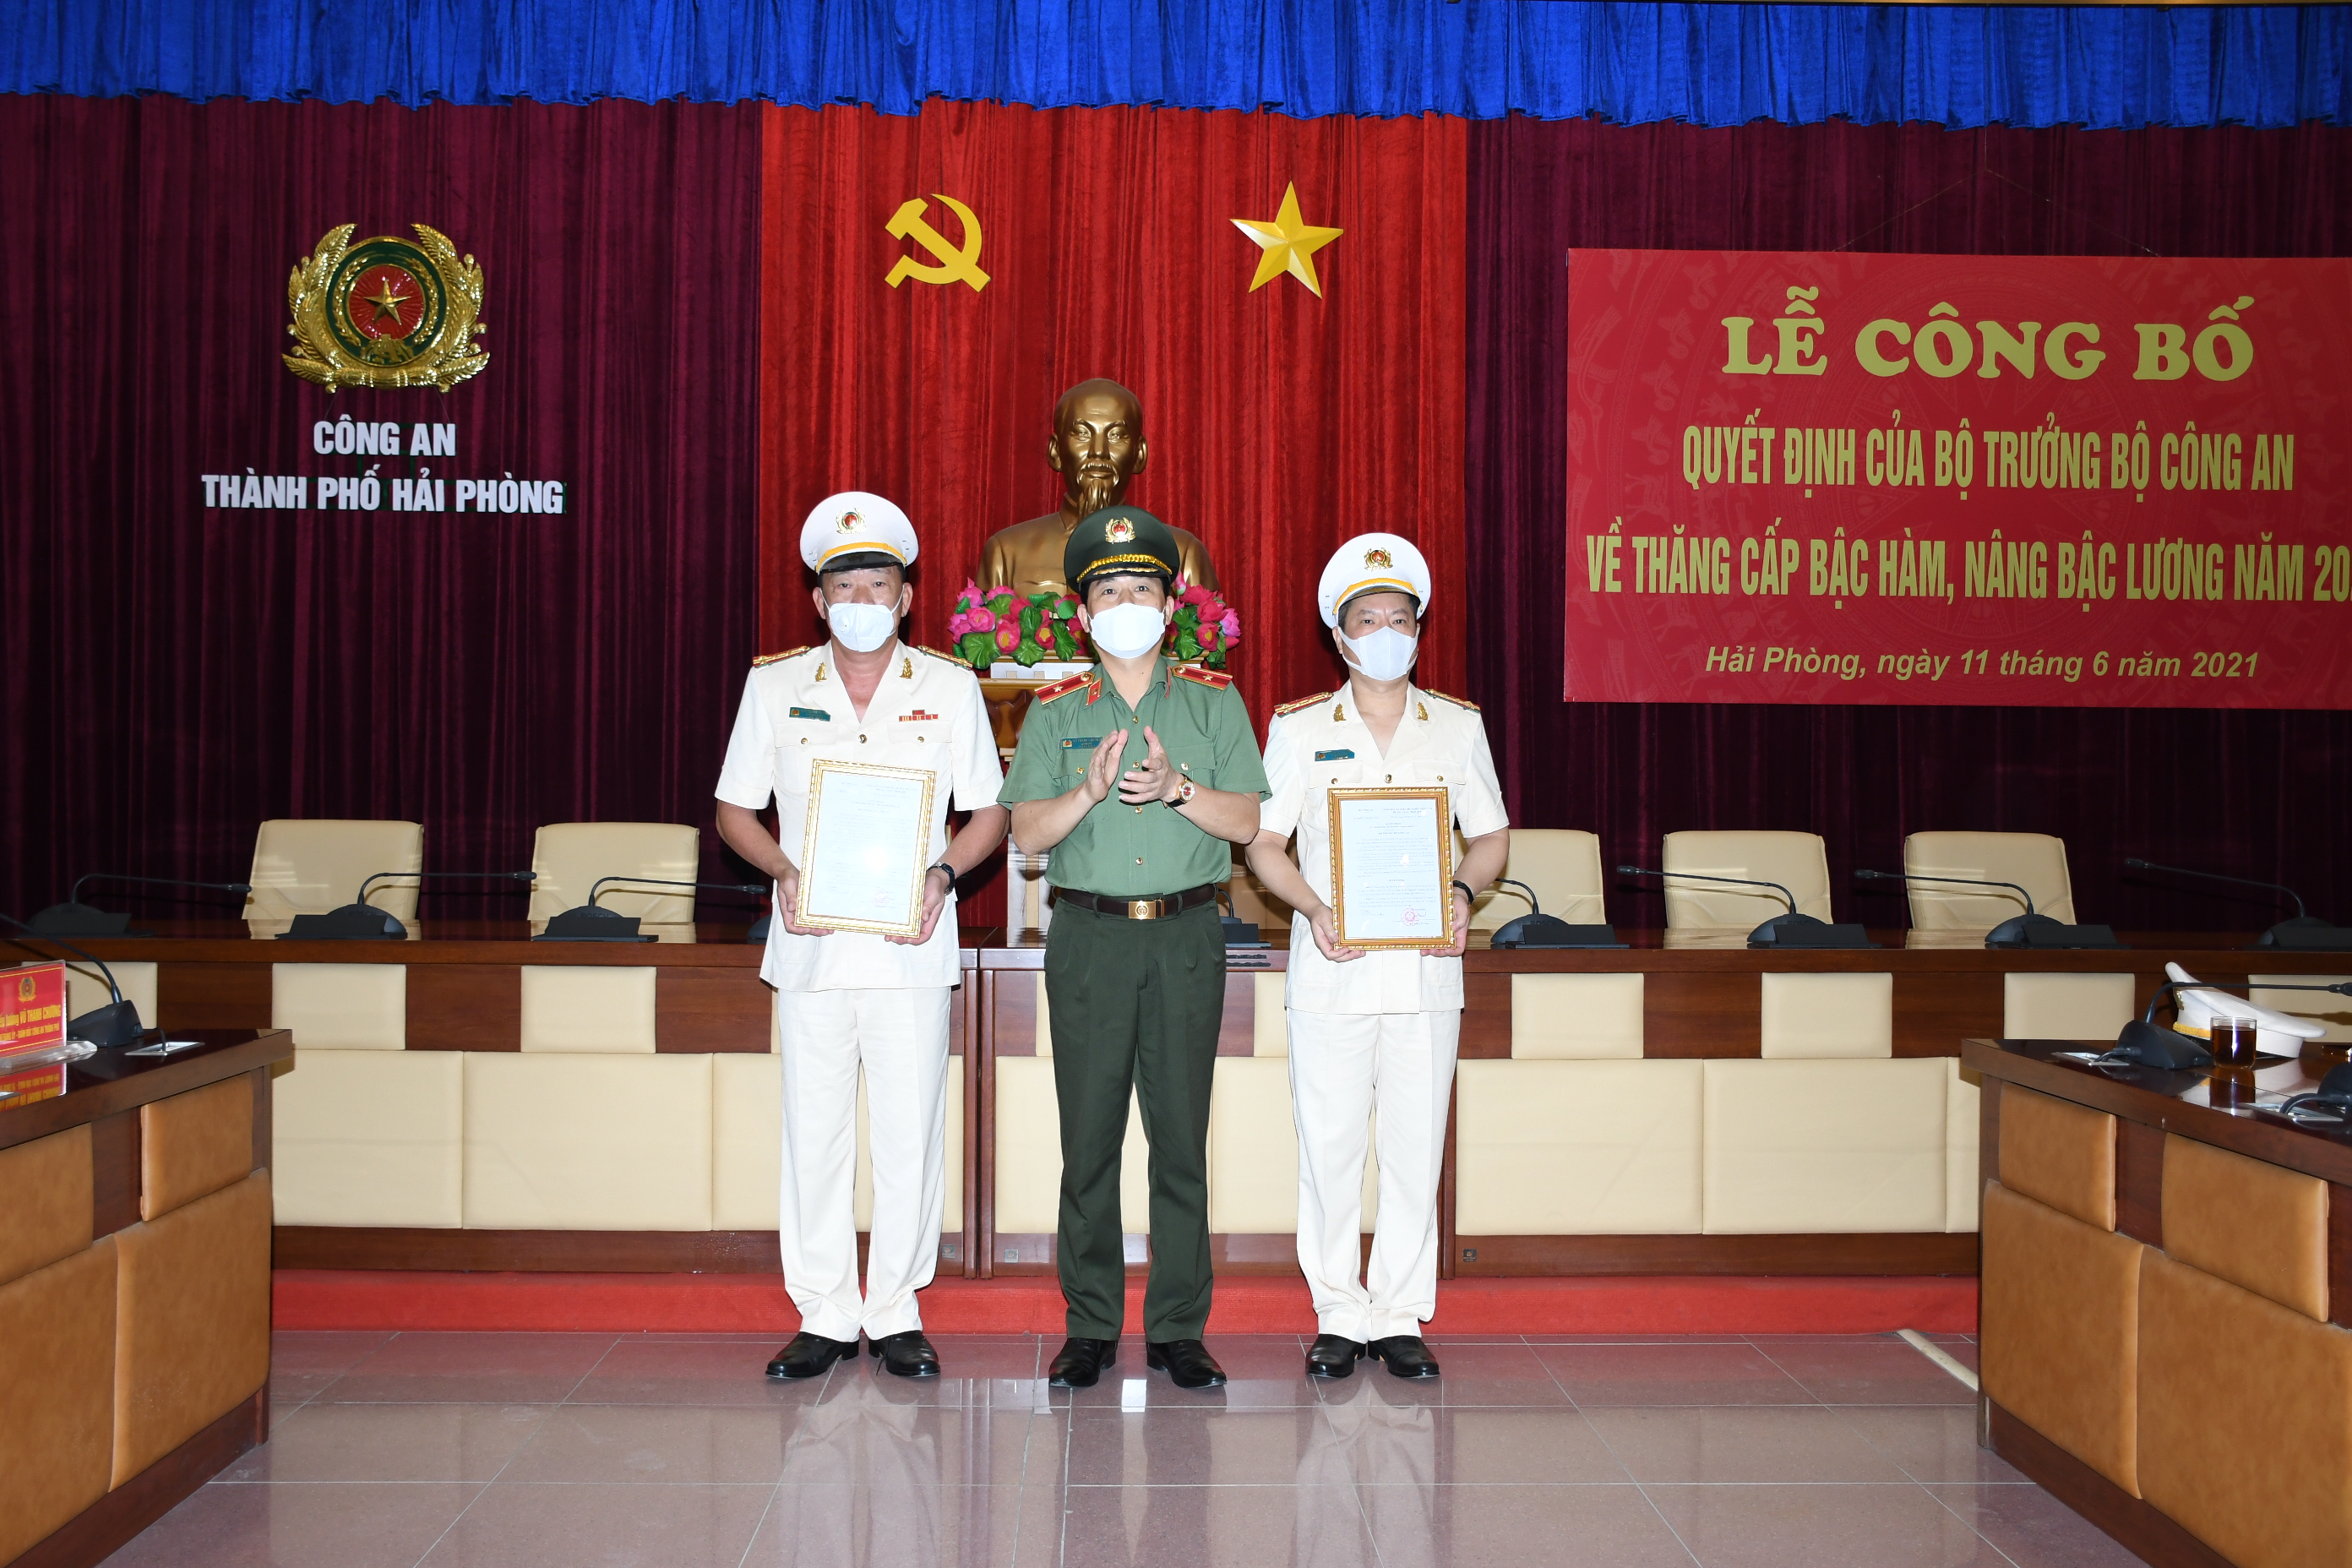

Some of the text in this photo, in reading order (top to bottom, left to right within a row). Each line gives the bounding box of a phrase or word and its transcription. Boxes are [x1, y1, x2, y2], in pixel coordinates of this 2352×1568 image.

[1722, 286, 2255, 382] LỄ CÔNG BỐ
[313, 413, 456, 456] CÔNG AN
[1683, 407, 2295, 503] QUYẾT ĐỊNH CỦA BỘ TRƯỞNG BỘ CÔNG AN
[201, 464, 564, 514] THÀNH PHỐ HẢI PHÒNG
[1586, 516, 2352, 612] VỀ THĂNG CẤP BẬC HÀM, NÂNG BẬC LƯƠNG NĂM 20
[1706, 646, 2258, 683] Hải Phòng, ngày 11 tháng 6 năm 2021
